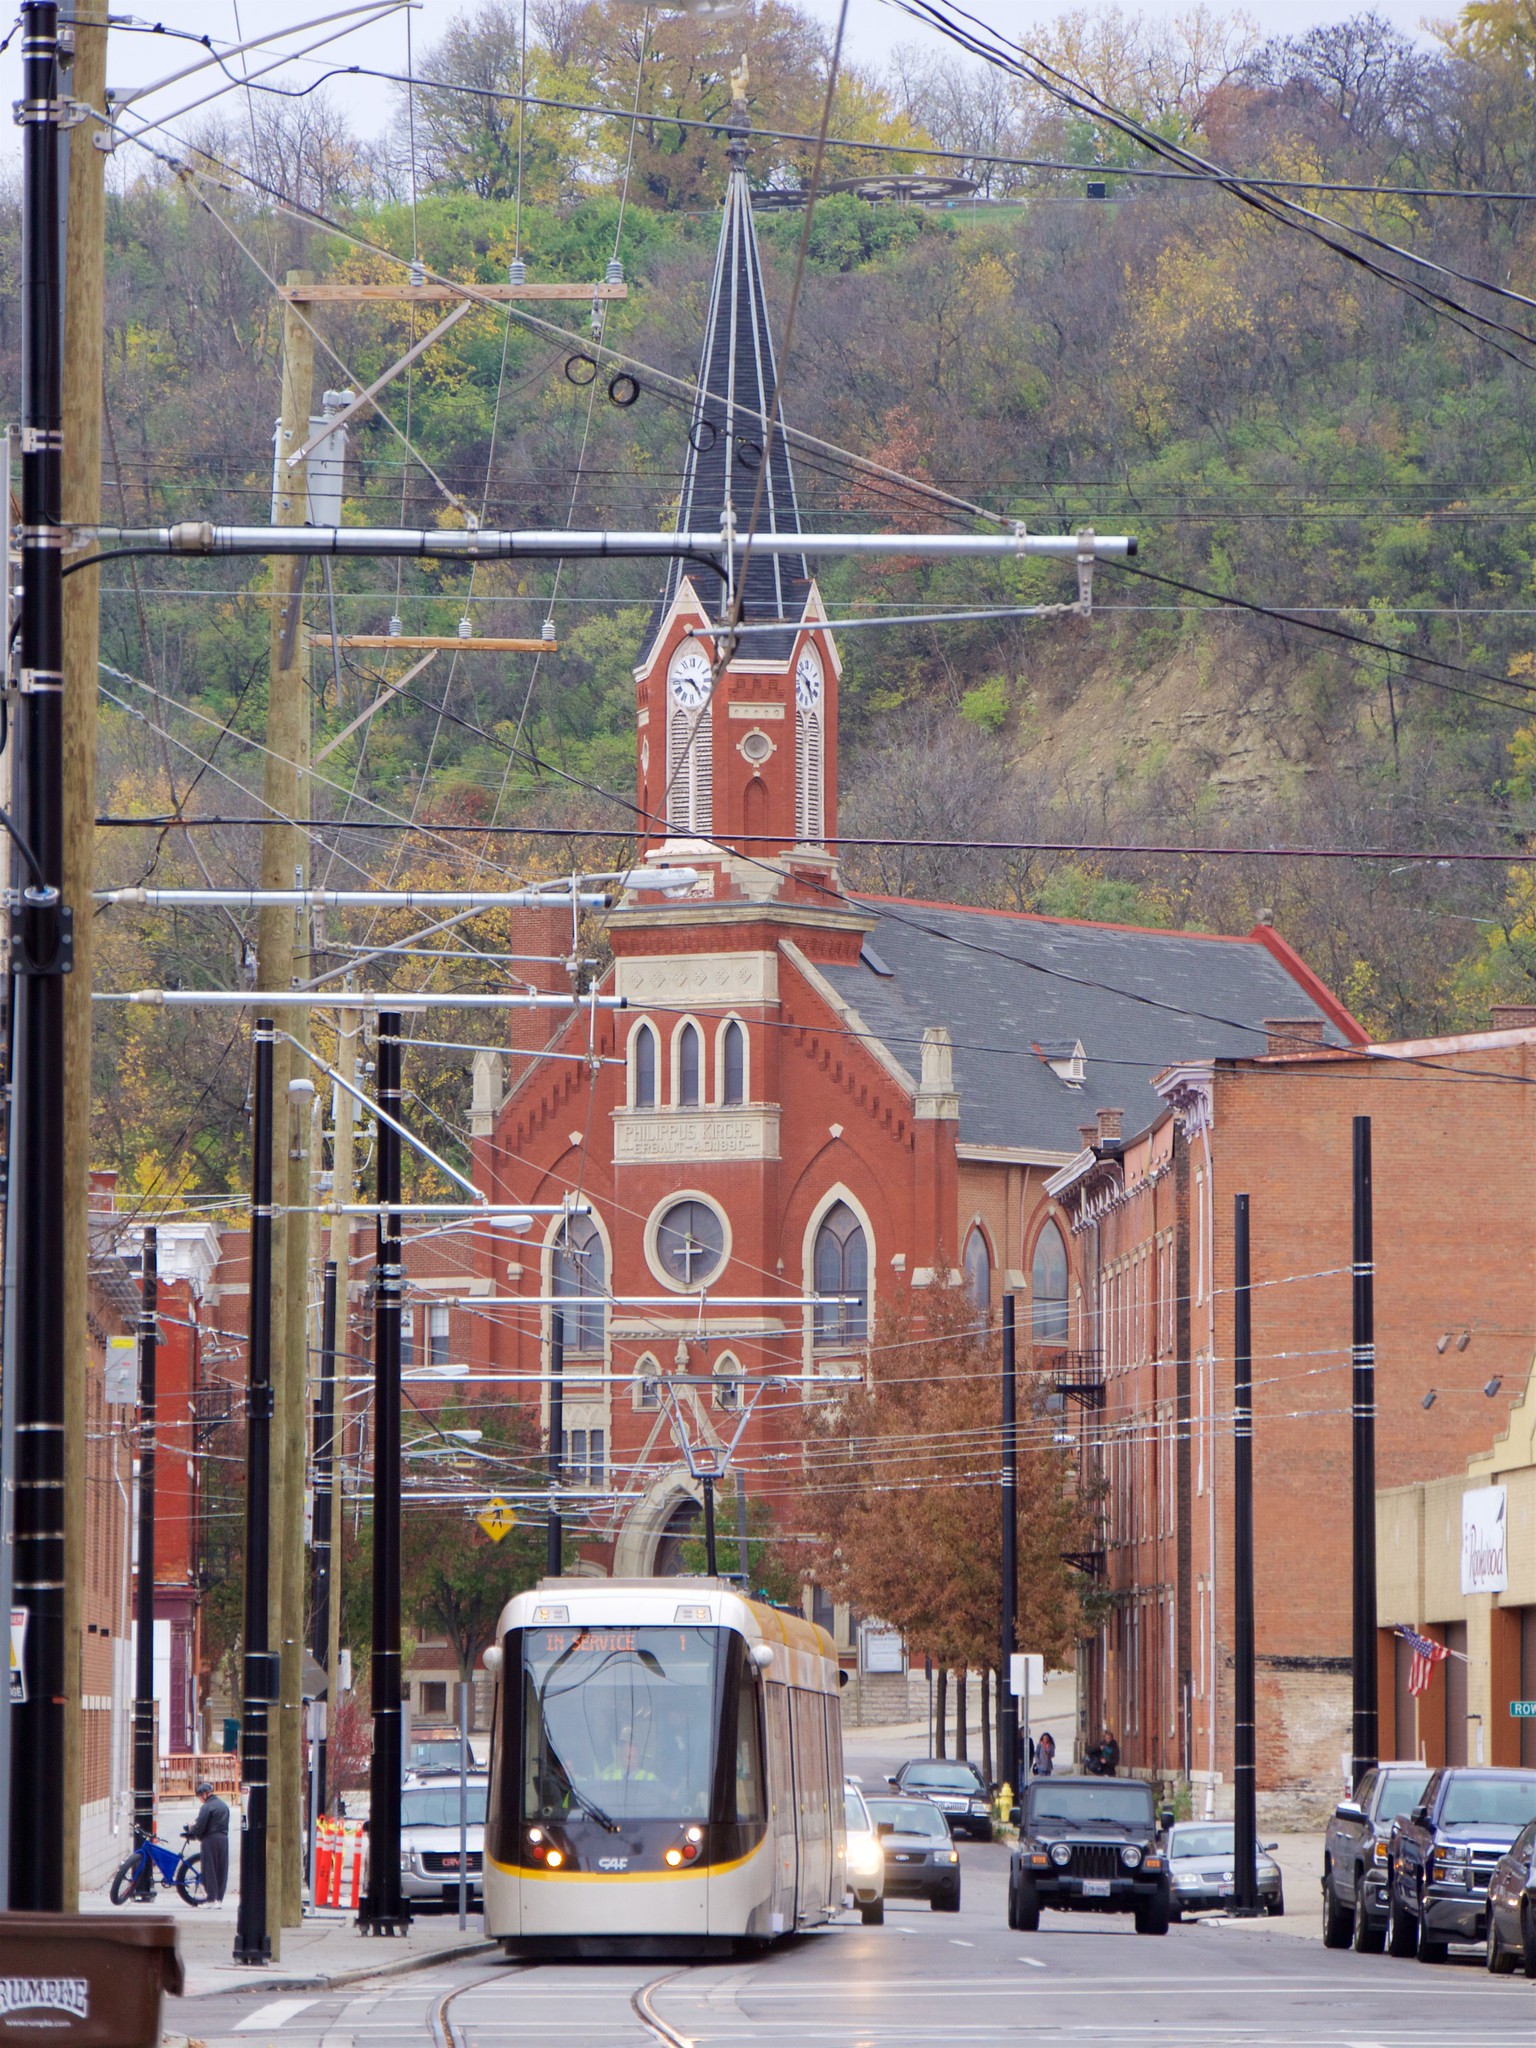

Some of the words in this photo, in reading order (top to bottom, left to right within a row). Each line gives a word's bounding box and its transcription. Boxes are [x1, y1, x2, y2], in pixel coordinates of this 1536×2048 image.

[624, 1124, 697, 1142] PHILIPPUS
[702, 1122, 753, 1140] KIRCHE
[545, 1633, 564, 1651] IN
[572, 1632, 636, 1651] SERVICE
[598, 1857, 628, 1870] CAF
